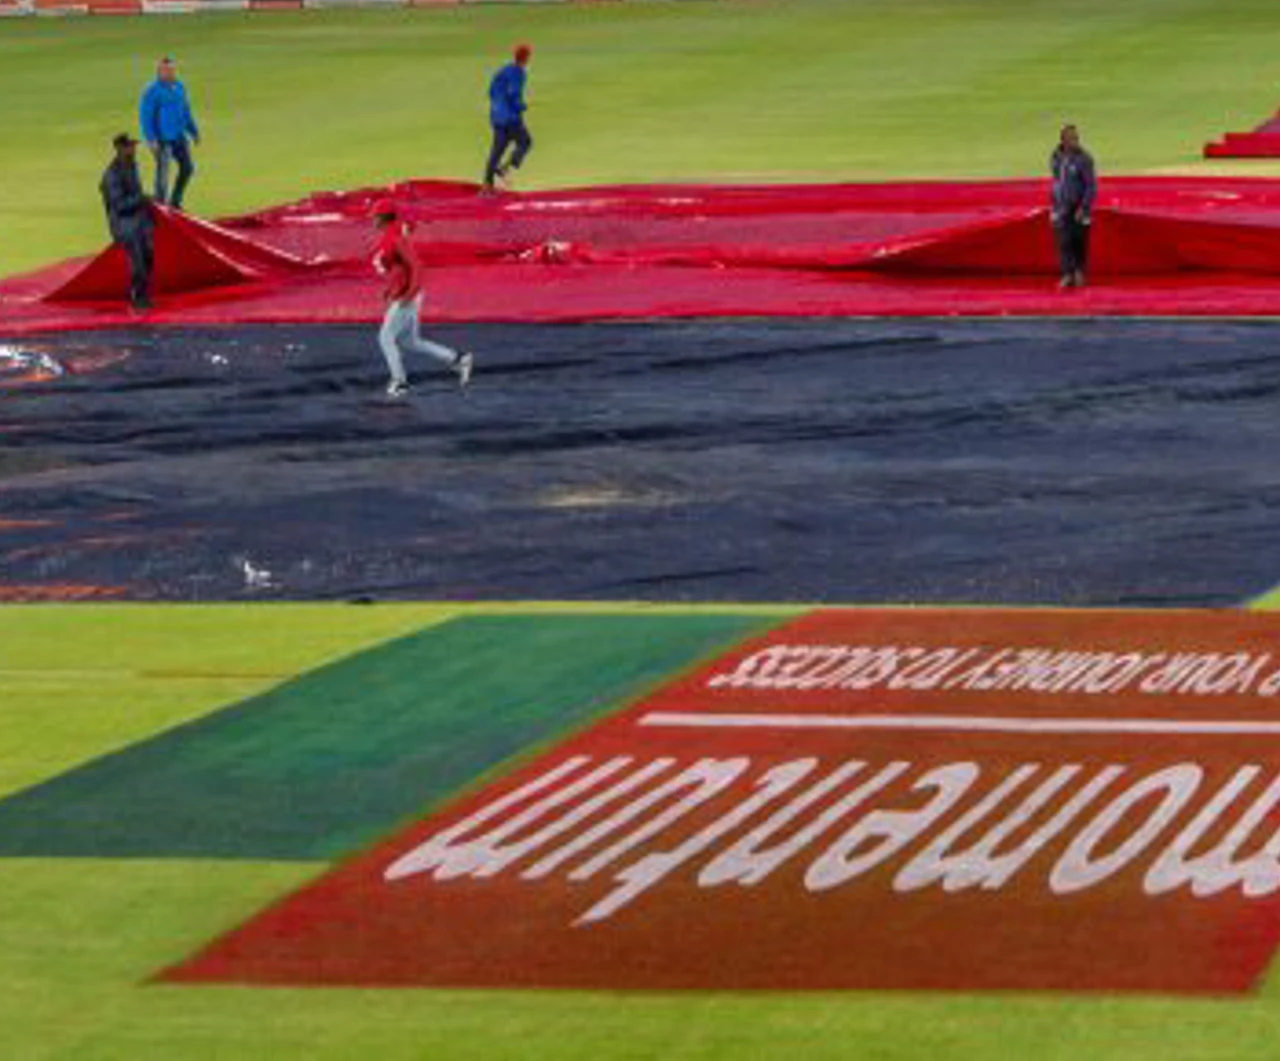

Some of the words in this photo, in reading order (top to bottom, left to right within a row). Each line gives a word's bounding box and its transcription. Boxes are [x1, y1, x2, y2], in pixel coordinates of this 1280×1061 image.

[883, 646, 980, 690] TO
[940, 647, 1167, 694] JOURNEY
[1139, 650, 1271, 695] YOUR
